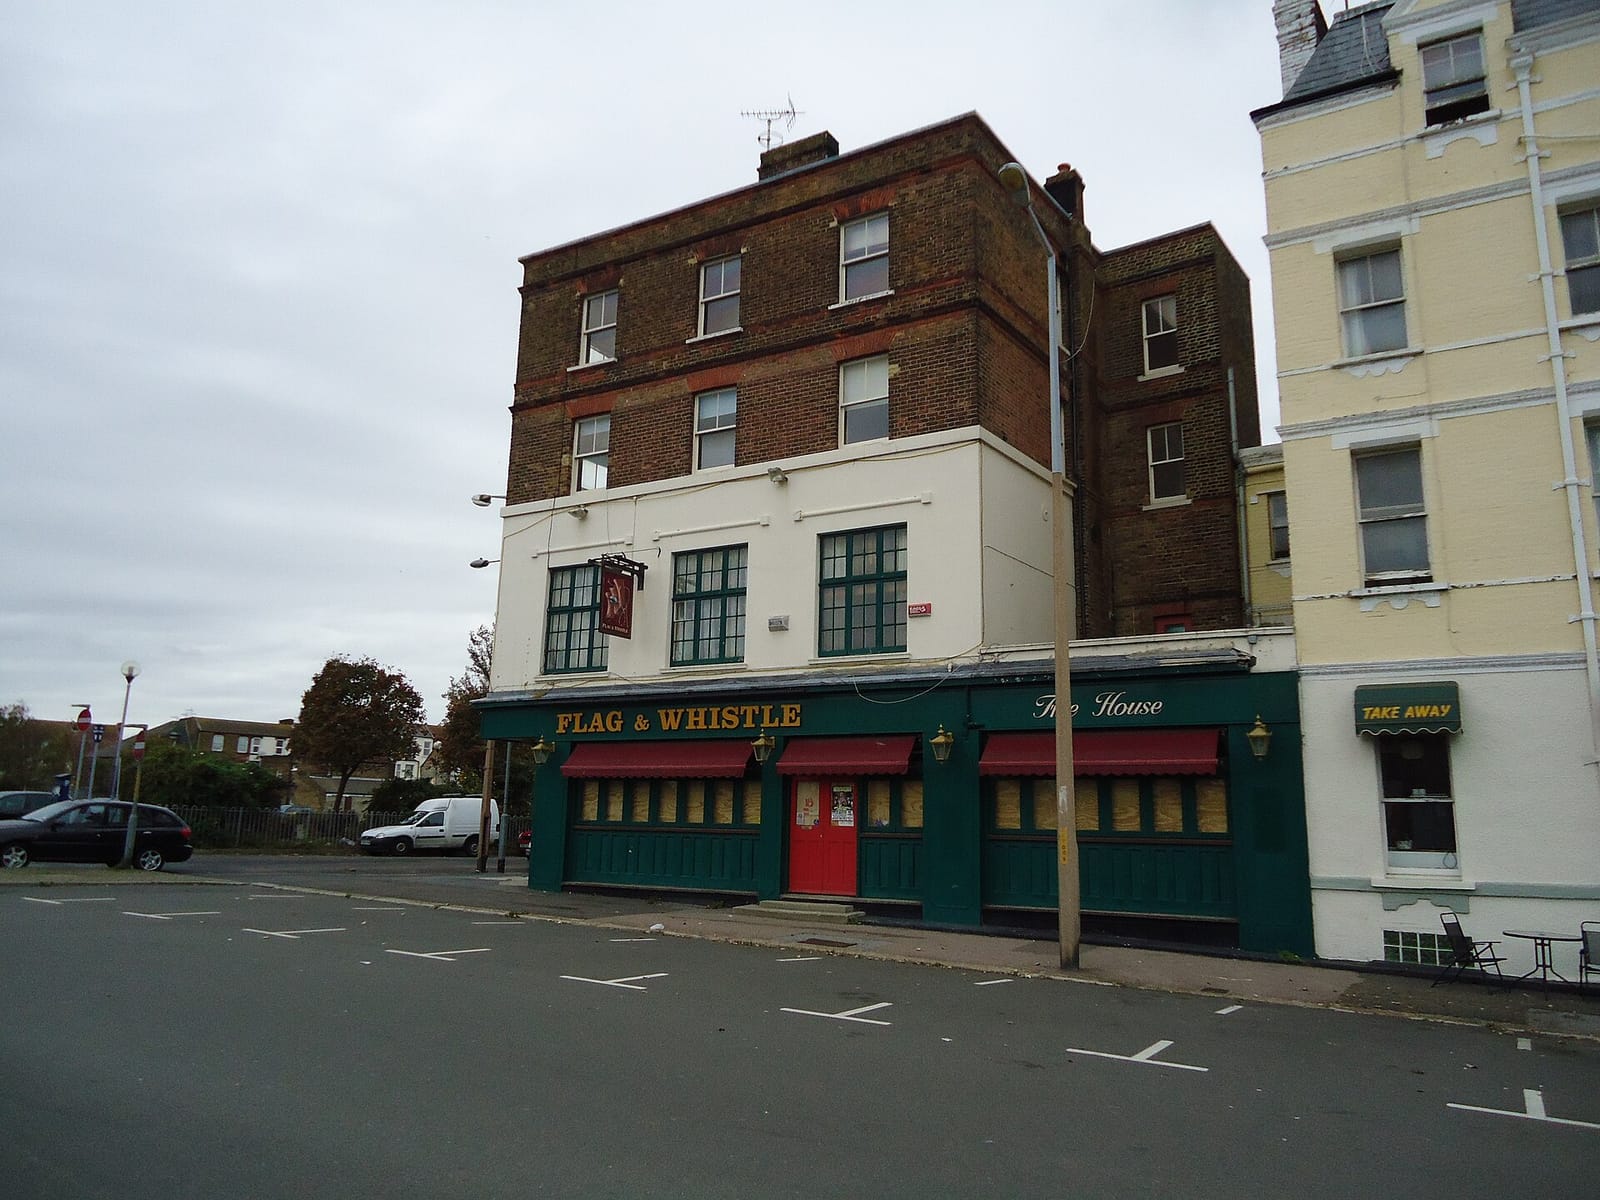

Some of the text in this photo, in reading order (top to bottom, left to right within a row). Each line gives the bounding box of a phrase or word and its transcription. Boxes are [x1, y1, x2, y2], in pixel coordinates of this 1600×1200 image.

[556, 704, 801, 734] FLAG & WHISTLE
[1033, 691, 1164, 719] Fre House
[1362, 704, 1452, 720] TAKE AWAY
